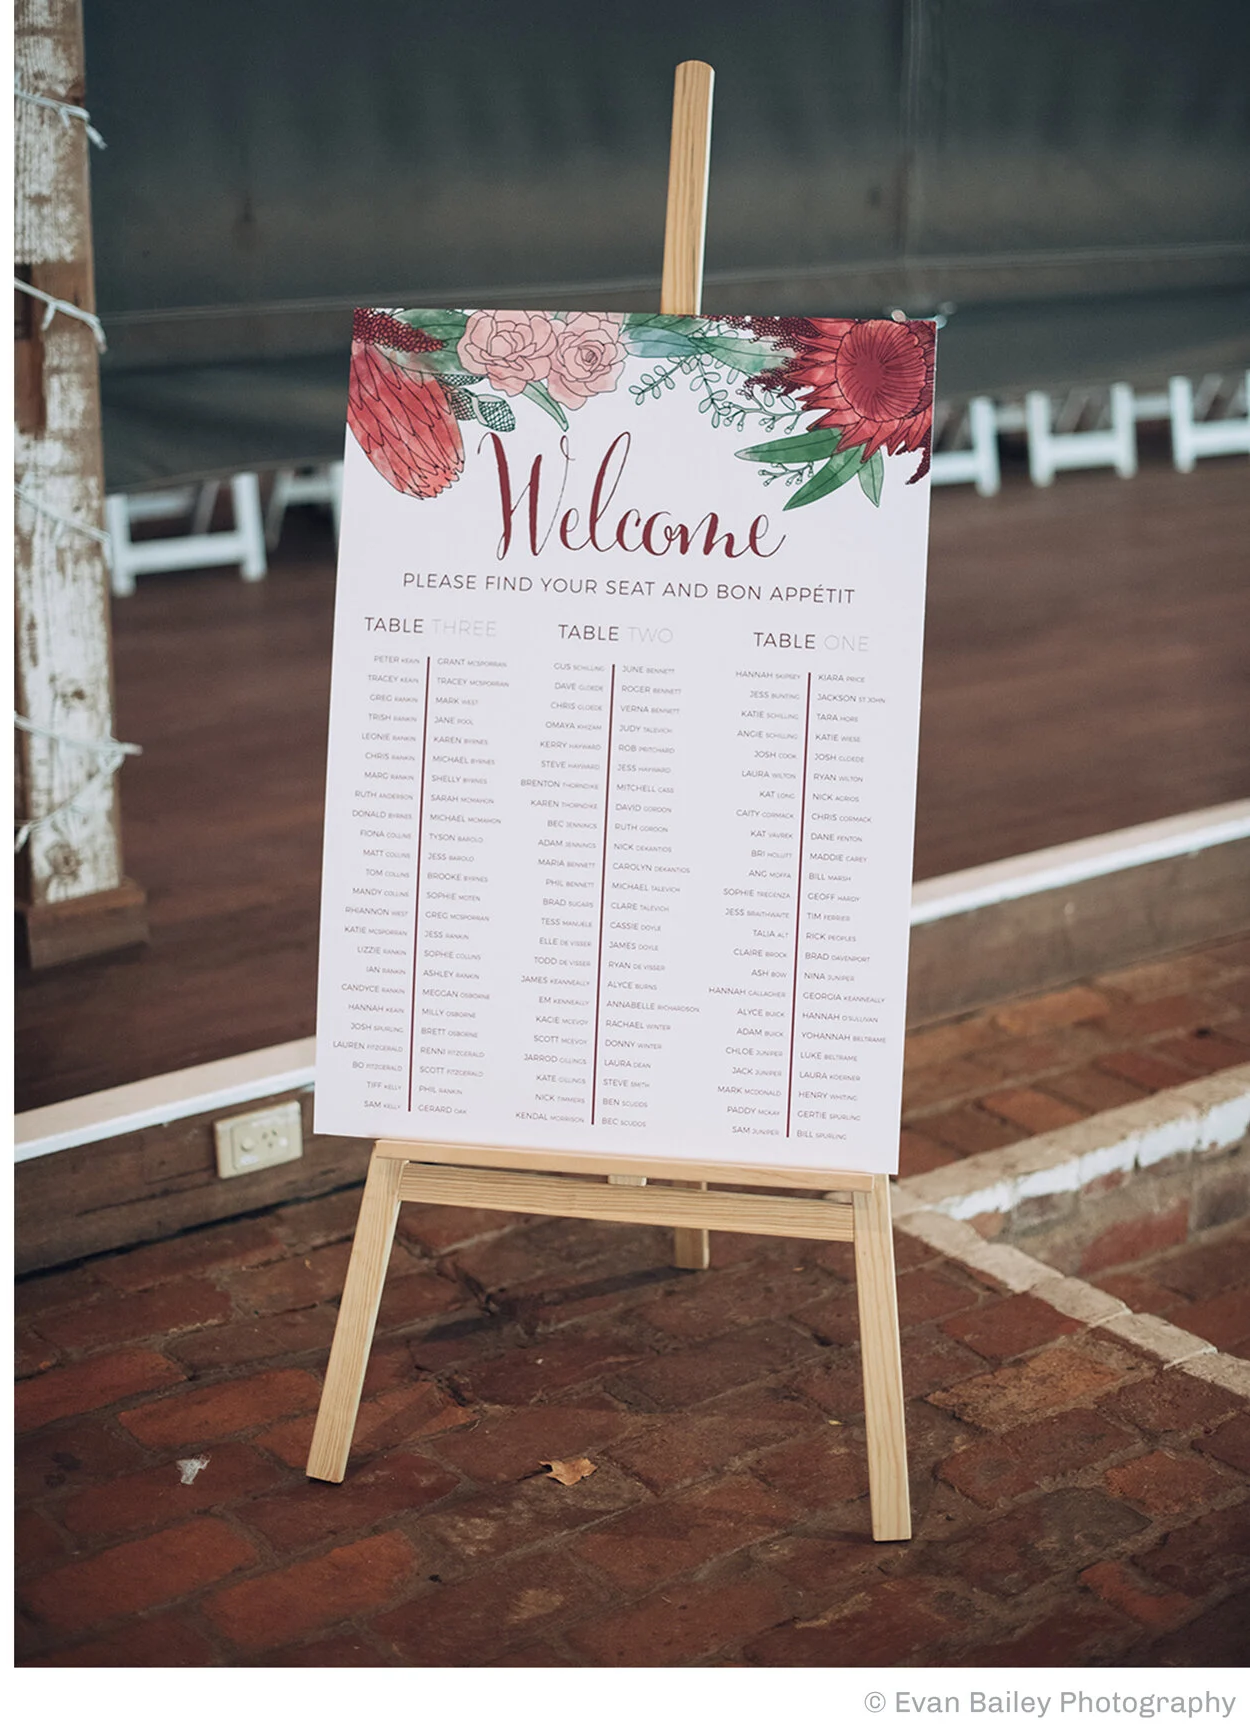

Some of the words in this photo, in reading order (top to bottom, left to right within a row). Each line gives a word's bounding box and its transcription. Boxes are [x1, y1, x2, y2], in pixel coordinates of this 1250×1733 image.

[477, 431, 786, 561] Welcome
[403, 573, 477, 590] PLEASE
[485, 576, 533, 592] FIND
[541, 578, 597, 594] YOUR
[606, 580, 655, 597] SEAT
[662, 582, 709, 598] AND
[717, 584, 762, 600] BON
[770, 584, 855, 604] APPÉTIT
[364, 616, 424, 634] TABLE
[432, 619, 497, 637] THREE
[559, 624, 619, 641] TABLE
[628, 627, 674, 644] TWO
[753, 632, 816, 650] TABLE
[824, 634, 869, 652] ONE
[374, 655, 399, 663] PETER
[367, 674, 398, 682] TRACEY
[437, 677, 467, 685] TRACEY
[749, 690, 769, 698] JESS
[550, 701, 575, 709] CHRIS
[619, 724, 640, 732] JUDY
[540, 740, 567, 748] KERRY
[754, 750, 776, 758] JOSH
[814, 753, 836, 761] JOSH
[432, 755, 468, 763] MICHAEL
[541, 760, 565, 768] STEVE
[617, 763, 636, 771] JESS
[520, 779, 560, 787] BRENTON
[616, 783, 655, 792] MITCHELL
[530, 799, 559, 807] KAREN
[615, 803, 641, 811] DAVID
[352, 809, 386, 818] DONALD
[429, 814, 465, 822] MICHAEL
[360, 829, 384, 837] FIONA
[428, 852, 446, 860] JESS
[809, 853, 843, 861] MADDIE
[612, 862, 652, 871] CAROLYN
[611, 882, 648, 890] MICHAEL
[352, 887, 382, 895] MANDY
[723, 888, 753, 896] SOPHIE
[426, 891, 456, 900] SOPHIE
[542, 898, 566, 906] BRAD
[541, 917, 560, 925] TESS
[609, 921, 638, 929] CASSIE
[344, 925, 365, 933] KATIE
[424, 930, 443, 938] JESS
[609, 941, 636, 949] JAMES
[424, 950, 453, 958] SOPHIE
[733, 948, 762, 956] CLAIRE
[805, 952, 829, 960] BRAD
[534, 956, 557, 964] TODD
[423, 969, 453, 977] ASHLEY
[521, 975, 547, 983] JAMES
[348, 1003, 383, 1011] HANNAH
[606, 1000, 654, 1009] ANNABELLE
[421, 1008, 443, 1016] MILLY
[802, 1012, 839, 1020] HANNAH
[351, 1022, 371, 1030] JOSH
[421, 1027, 445, 1035] BRETT
[533, 1034, 558, 1043] SCOTT
[332, 1041, 365, 1049] LAUREN
[725, 1046, 753, 1055] CHLOE
[800, 1051, 821, 1059] LUKE
[604, 1059, 631, 1067] LAURA
[419, 1066, 444, 1074] SCOTT
[799, 1071, 827, 1079] LAURA
[603, 1078, 627, 1086] STEVE
[535, 1093, 554, 1101] NICK
[798, 1090, 828, 1098] HENRY
[727, 1106, 756, 1114] PADDY
[796, 1130, 813, 1138] BILL
